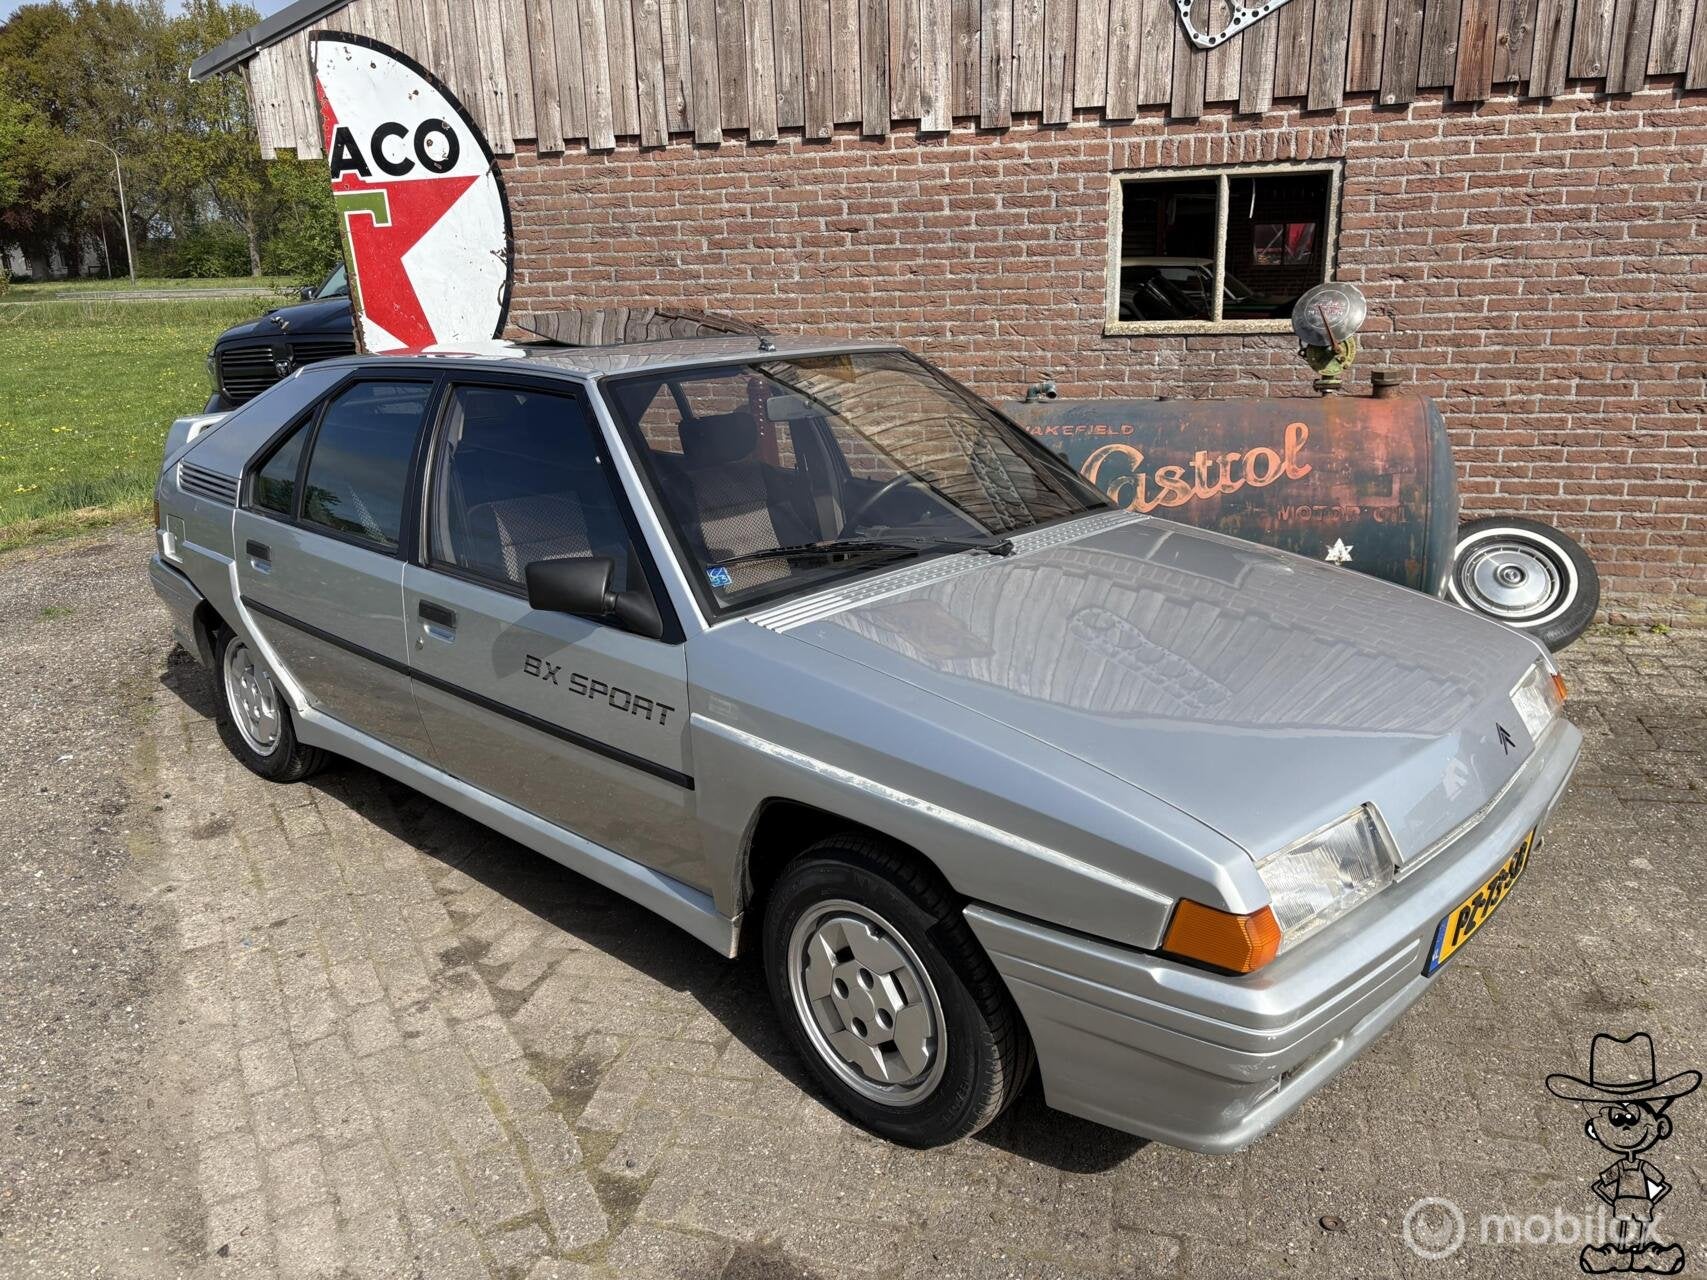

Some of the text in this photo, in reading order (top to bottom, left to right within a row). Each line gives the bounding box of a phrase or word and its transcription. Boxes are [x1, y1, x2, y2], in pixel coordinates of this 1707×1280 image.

[330, 118, 460, 179] ACO
[1025, 424, 1135, 436] AKEFIELD
[1080, 421, 1313, 513] Castrol
[524, 654, 675, 726] BX SPORT
